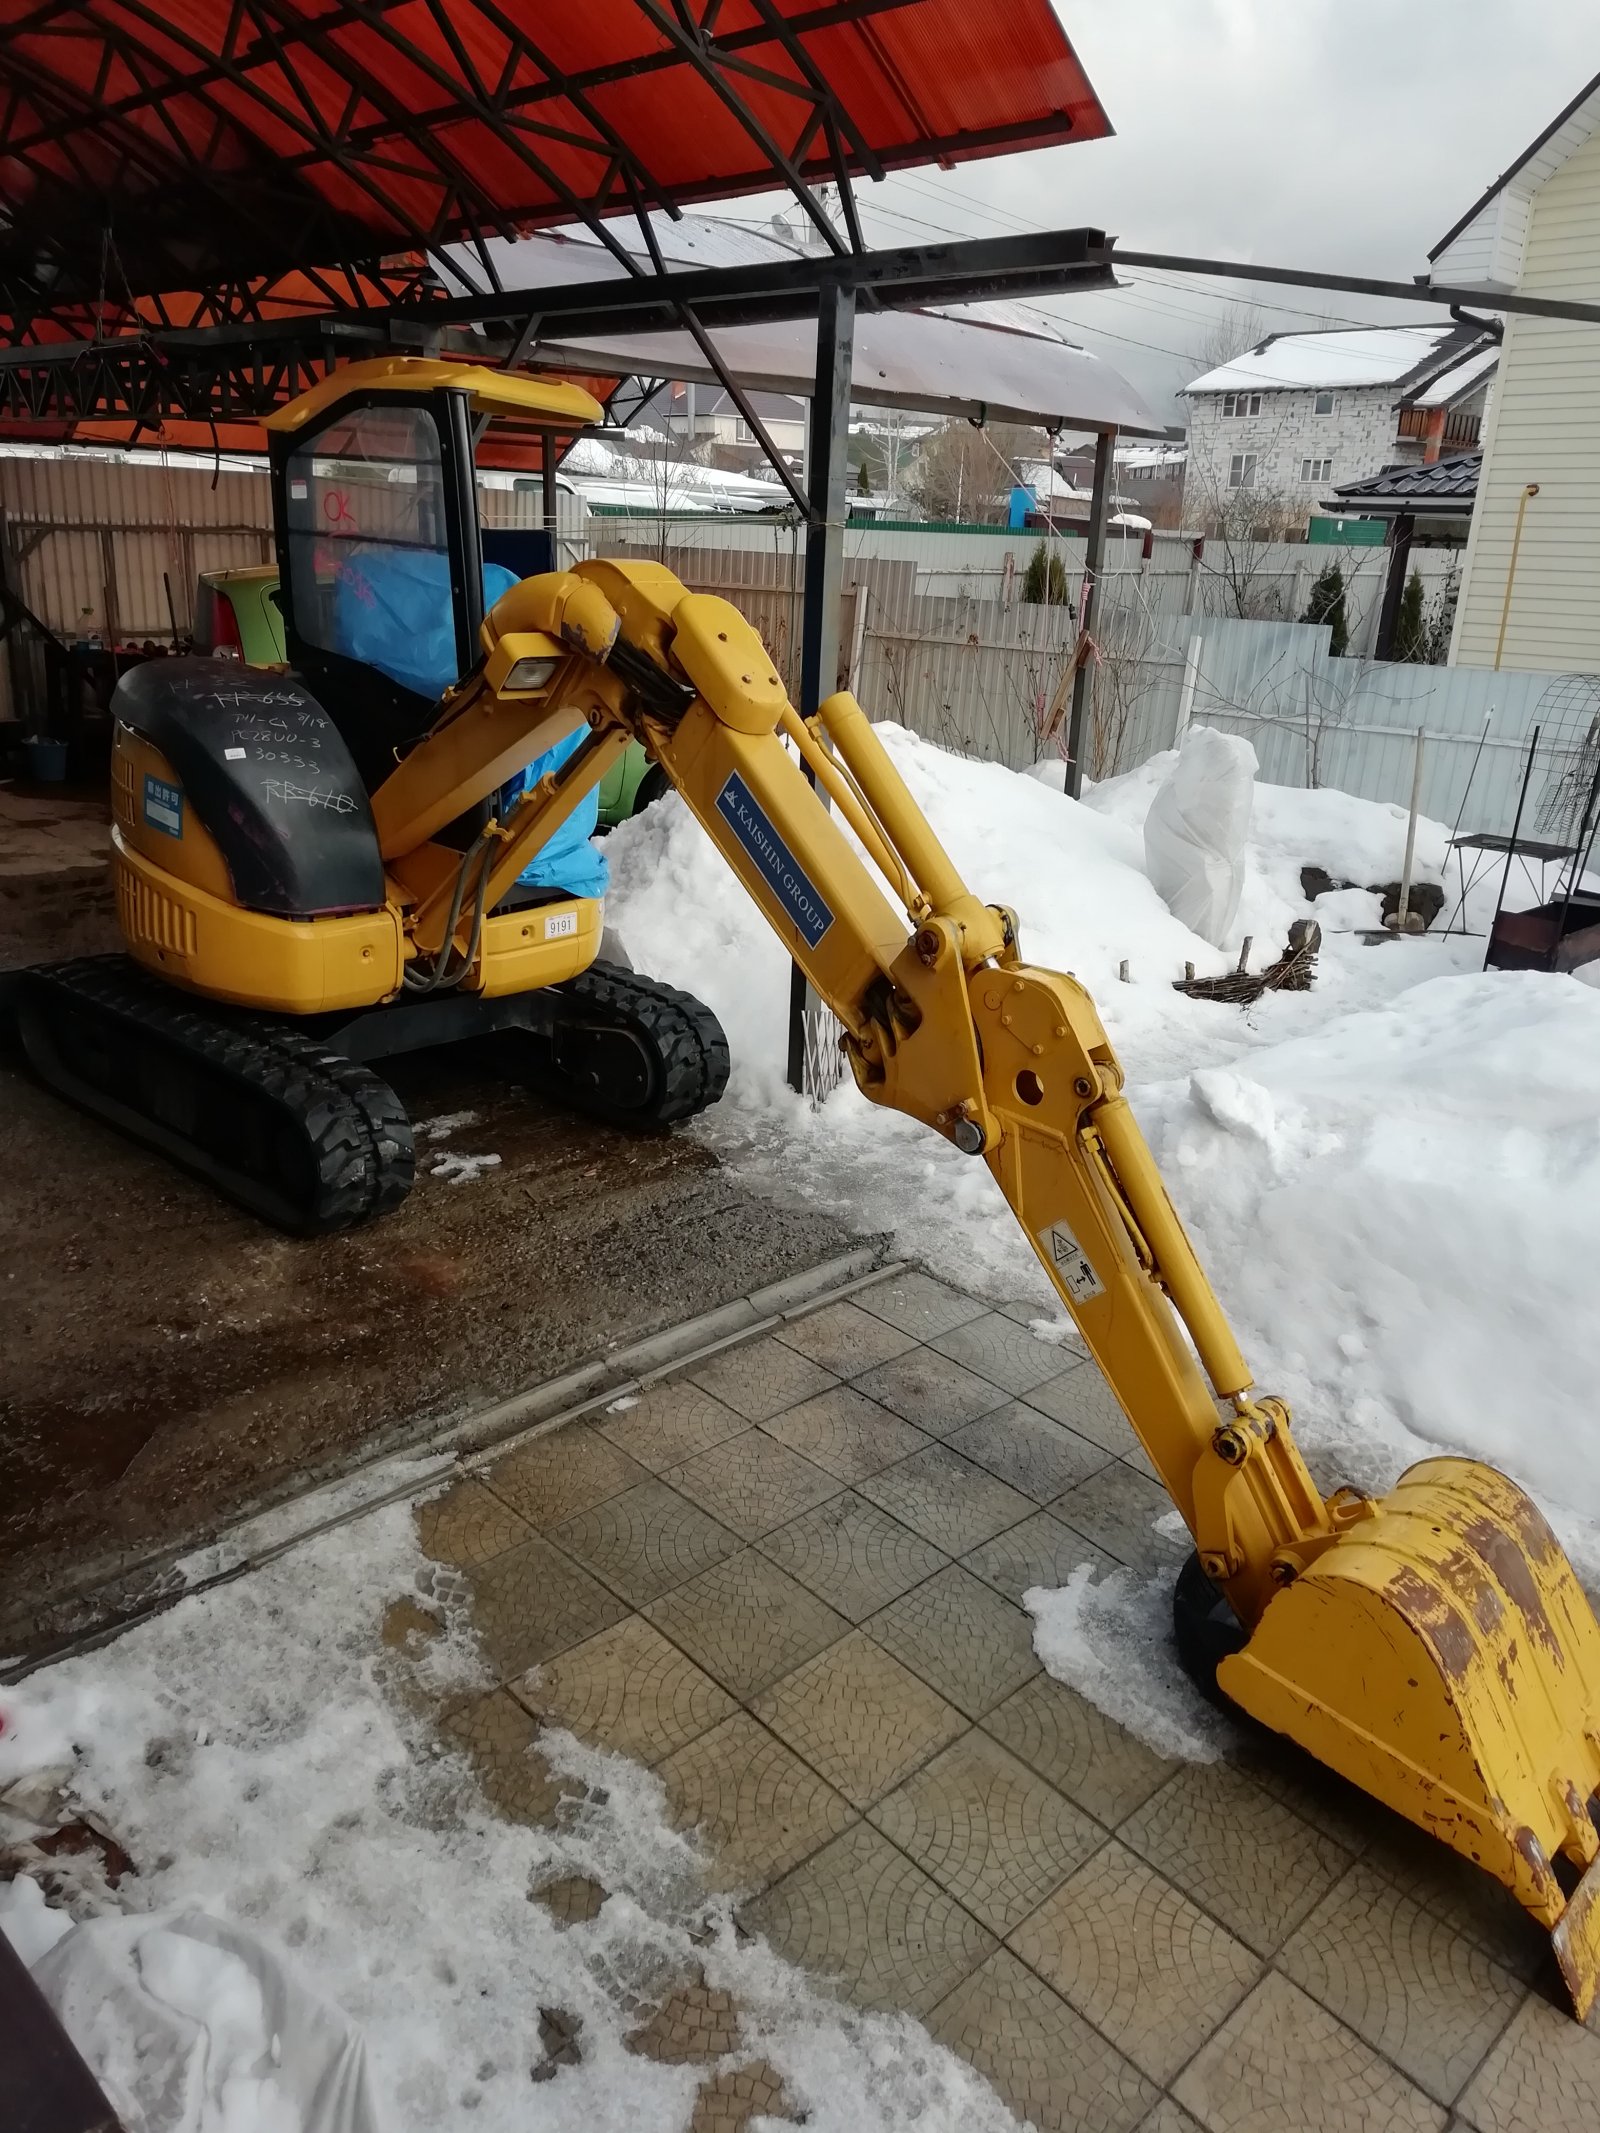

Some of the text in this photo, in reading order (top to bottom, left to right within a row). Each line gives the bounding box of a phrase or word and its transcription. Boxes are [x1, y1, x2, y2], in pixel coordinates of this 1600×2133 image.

[323, 490, 356, 522] OK
[255, 747, 321, 774] 30333
[736, 804, 825, 932] KAISHIN GROUP
[550, 919, 571, 934] 9191
